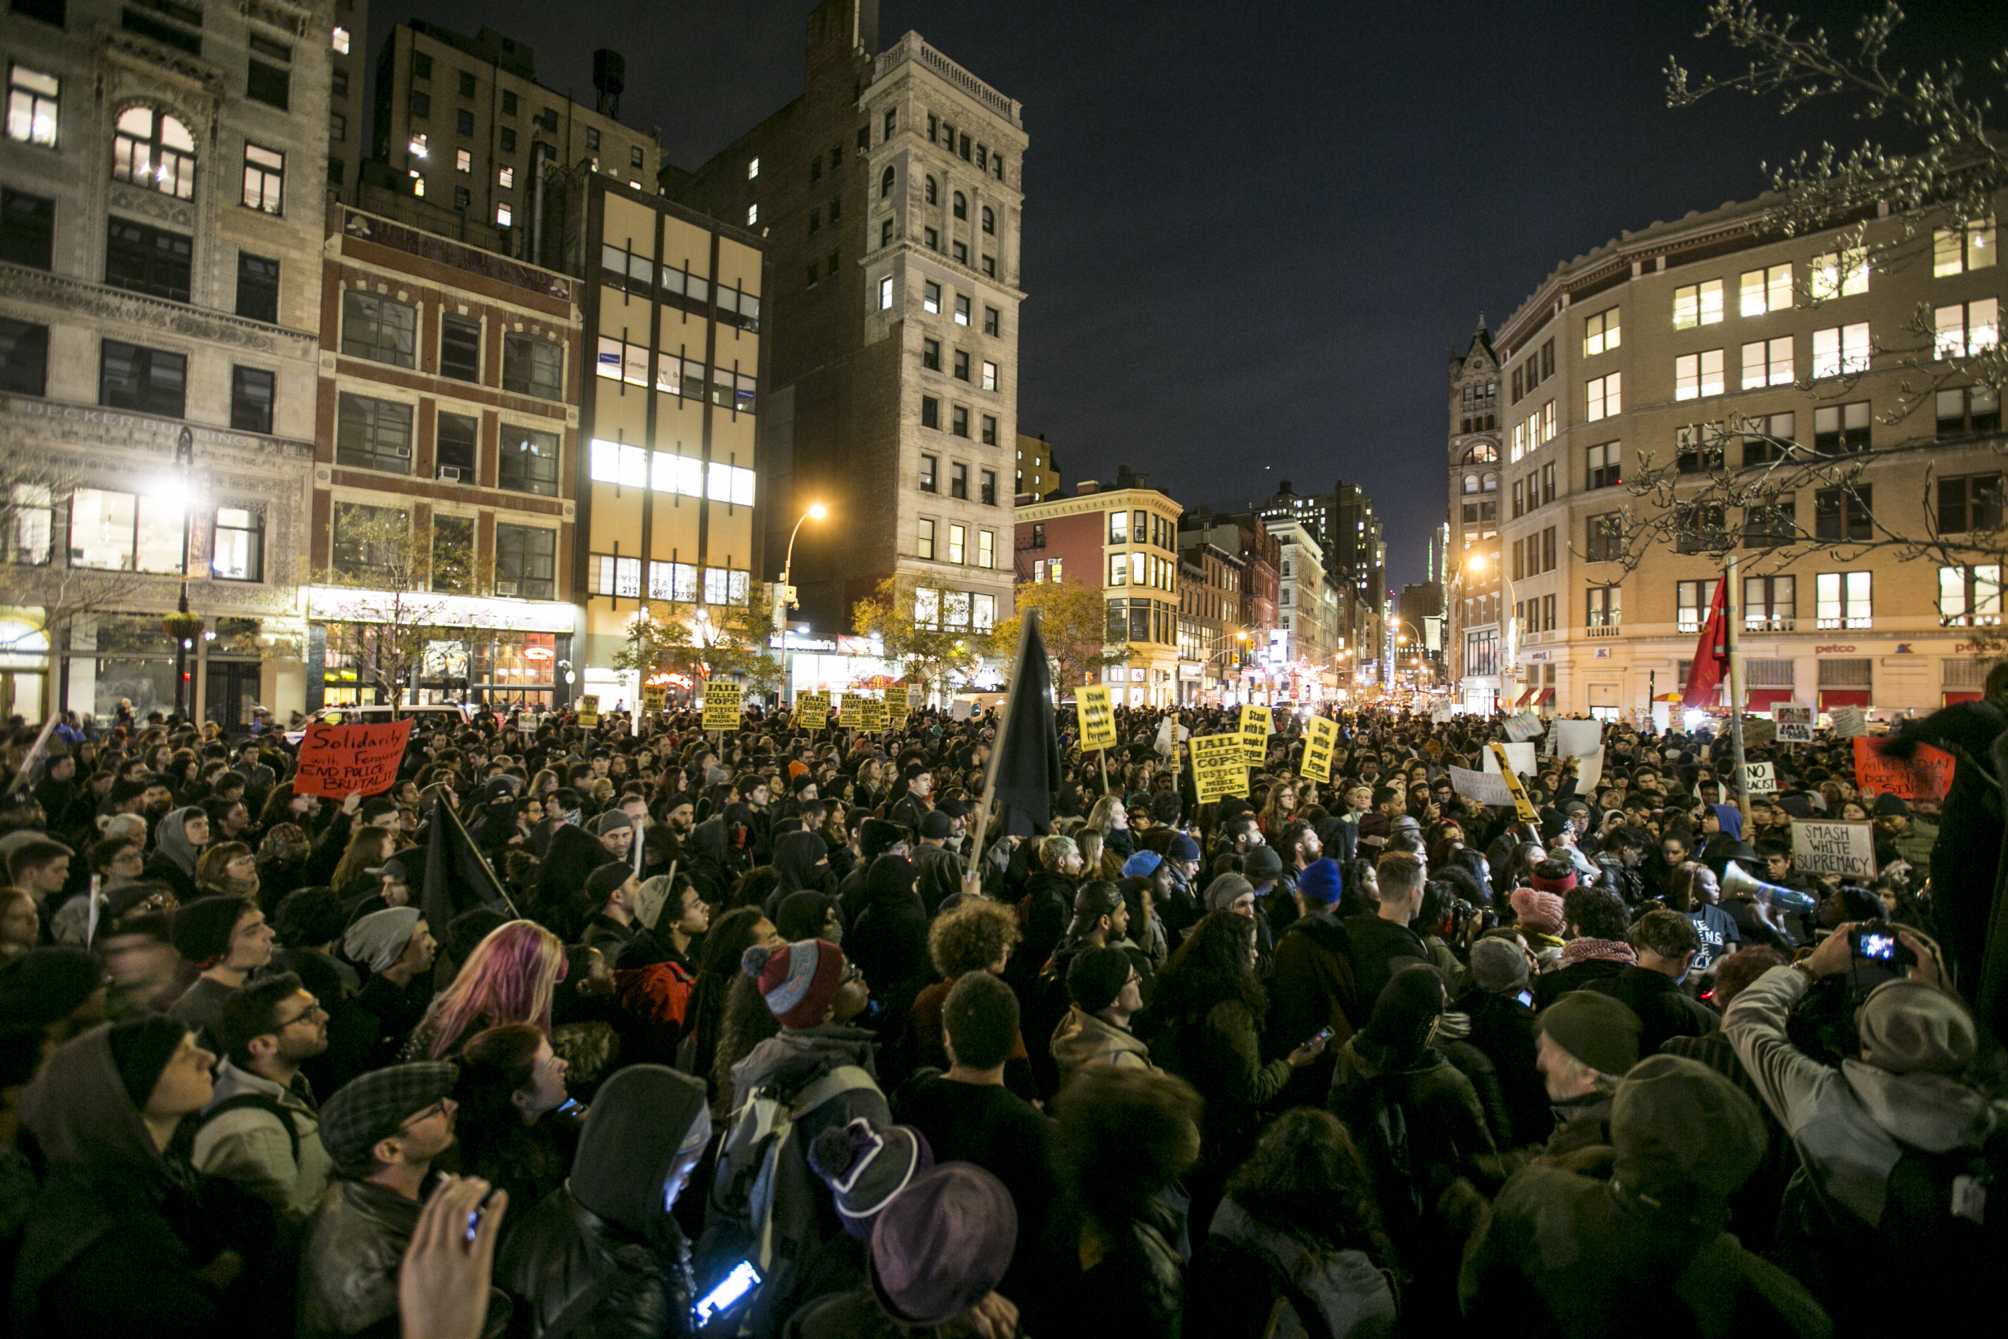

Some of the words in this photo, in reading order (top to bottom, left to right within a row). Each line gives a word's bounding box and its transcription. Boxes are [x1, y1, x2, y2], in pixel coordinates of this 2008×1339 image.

[26, 400, 136, 427] DECKER
[143, 418, 250, 447] BUIDING
[1815, 644, 1856, 654] petco
[1249, 710, 1267, 722] Stand
[1244, 724, 1257, 733] with
[312, 729, 402, 750] Solidarity
[1195, 736, 1239, 751] JAIL
[1195, 748, 1243, 758] KILLER
[301, 763, 339, 777] END
[344, 765, 383, 778] POLICE
[1198, 766, 1244, 781] JUSTICE
[1746, 764, 1765, 778] NO
[1202, 784, 1245, 794] BROWN
[1806, 825, 1849, 840] SMASH
[1809, 840, 1850, 855] WHITE
[1796, 855, 1869, 877] SUPREMACY
